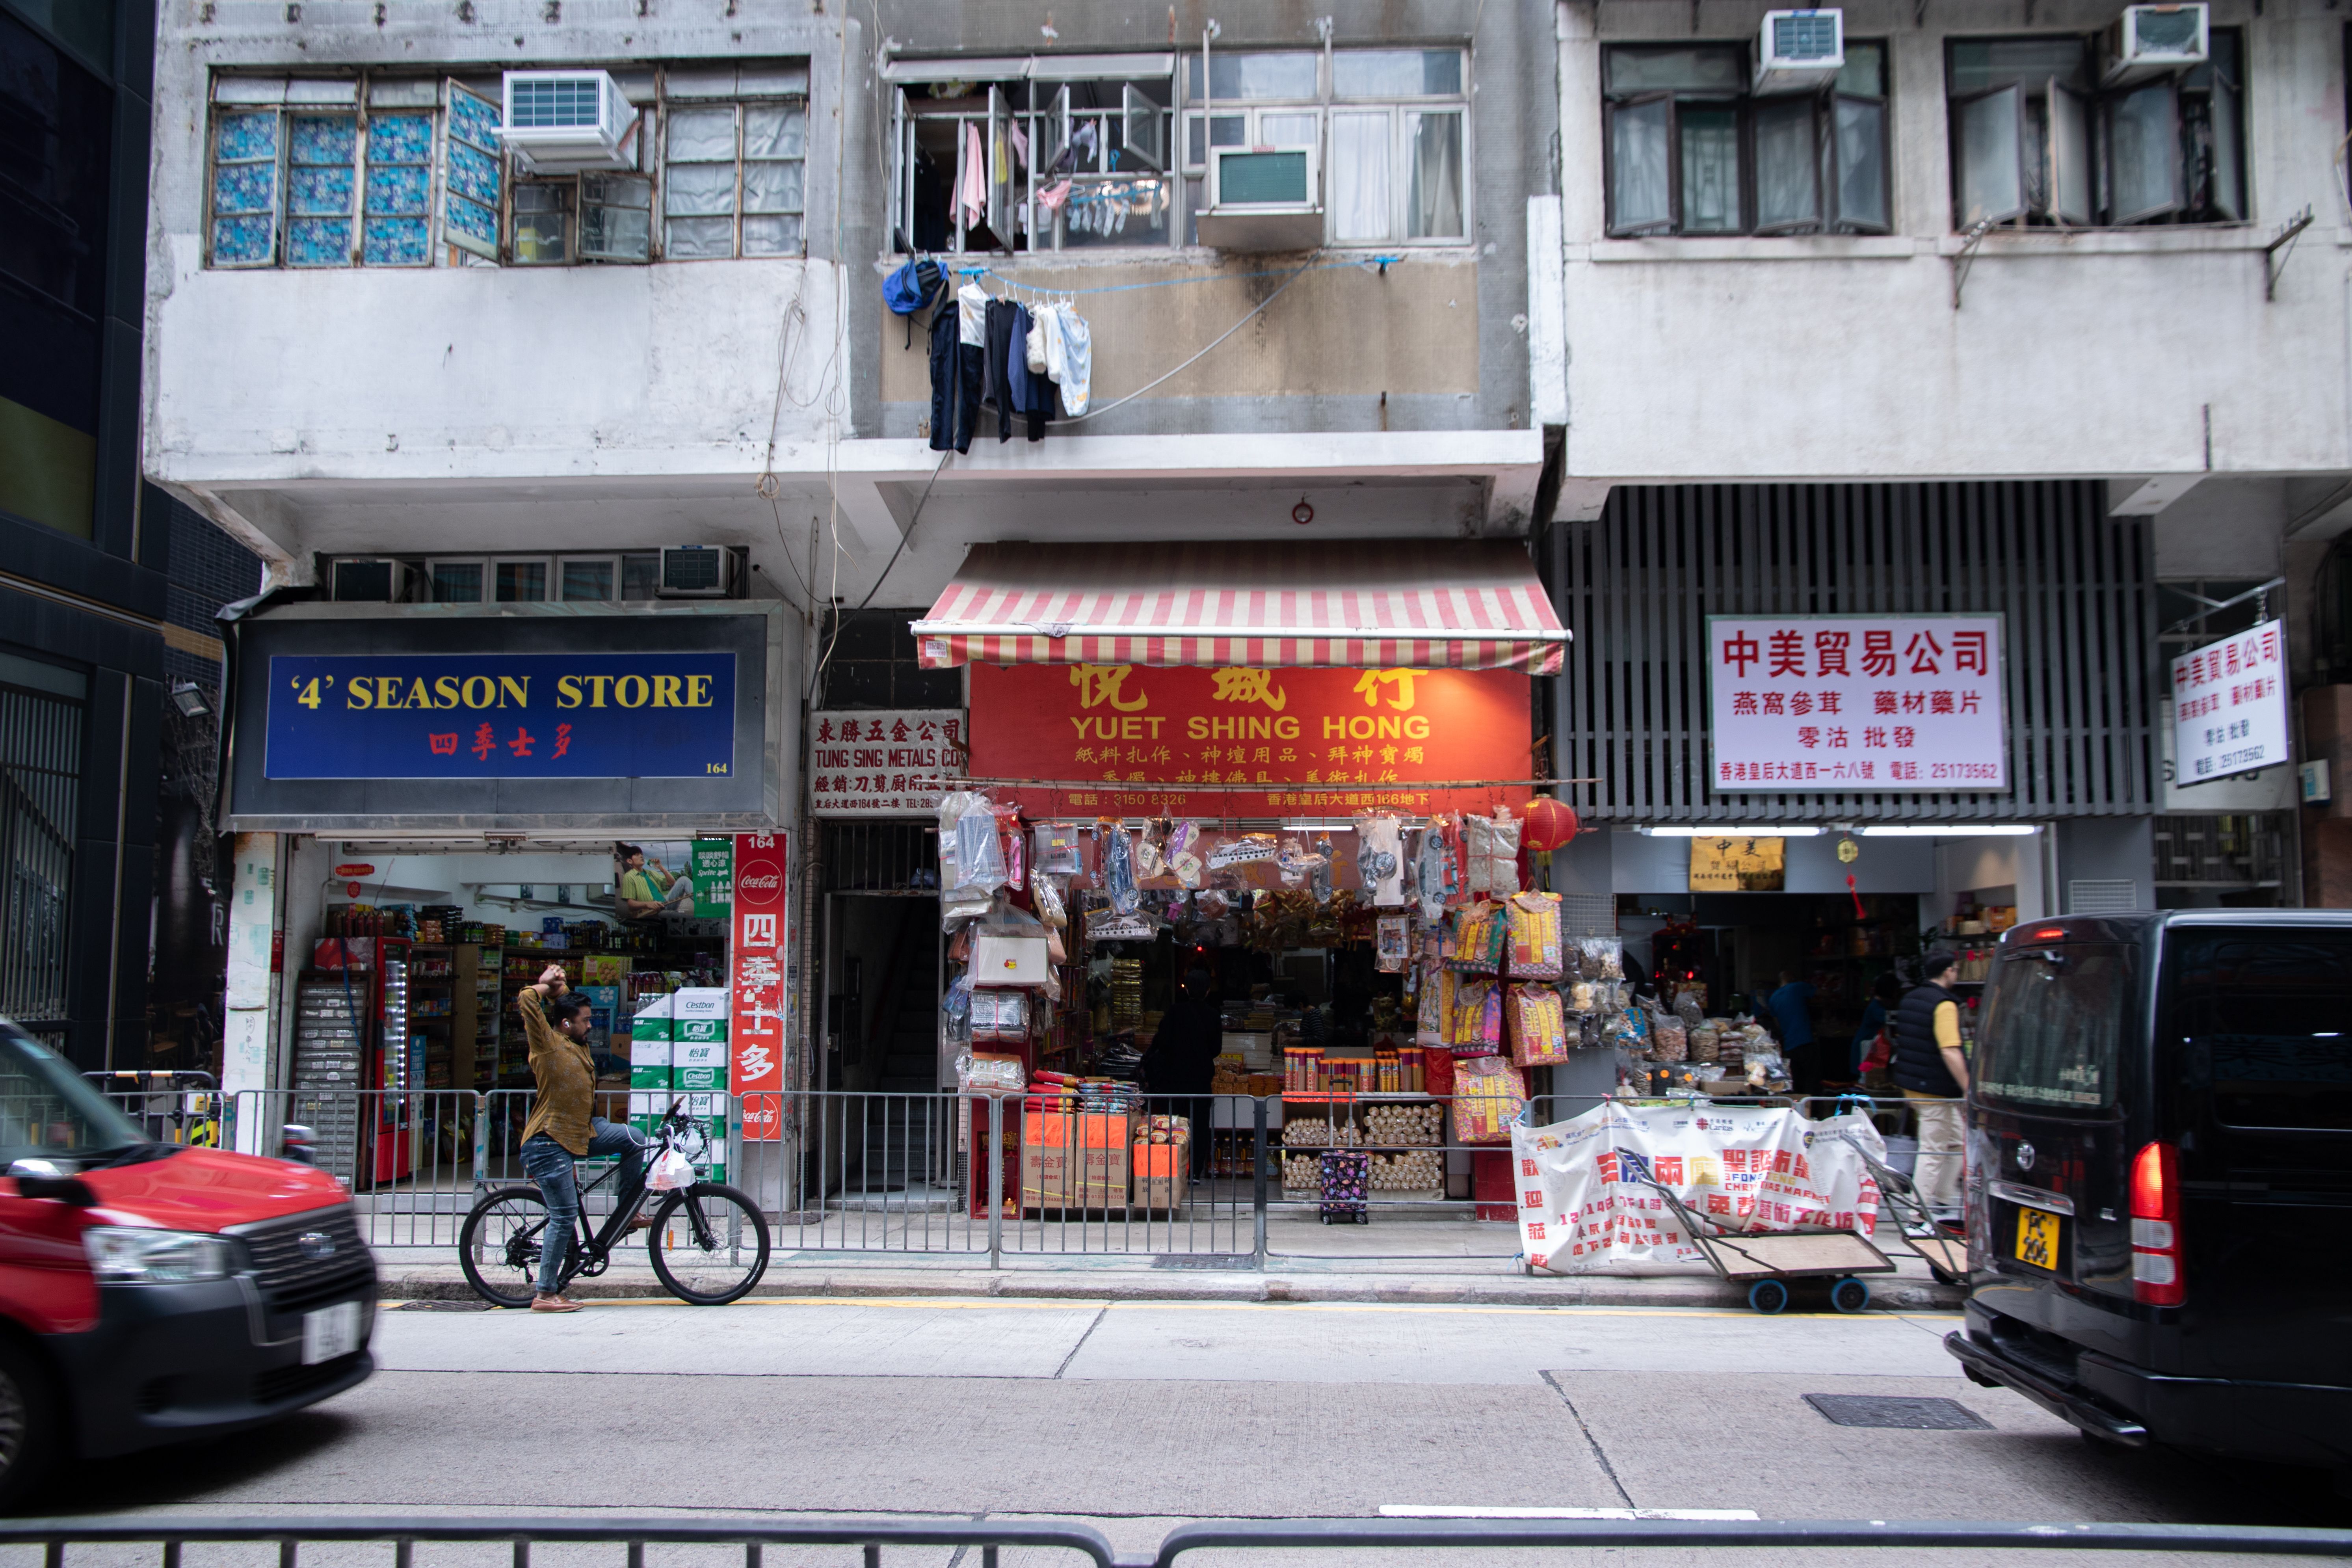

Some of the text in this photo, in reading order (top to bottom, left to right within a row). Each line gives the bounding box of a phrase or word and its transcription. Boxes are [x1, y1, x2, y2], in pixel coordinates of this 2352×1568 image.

[1723, 629, 1988, 678] 中美貿易公司
[2175, 630, 2278, 693] 中美貿易公司
[347, 675, 531, 709] SEASON
[556, 674, 714, 708] STORE
[1733, 690, 1982, 716] 燕窩參茸 藥材藥片
[815, 718, 960, 744] 東勝五金公司
[1069, 716, 1430, 739] YUET SHING HONG
[1863, 726, 1915, 748] 批發
[429, 722, 574, 761] 四季士多
[706, 763, 728, 774] 164
[815, 750, 849, 768] TUNG
[853, 750, 883, 768] SING
[888, 749, 935, 768] METALS
[1720, 761, 1875, 781] 香港皇后大道西一六八號
[1931, 763, 1997, 779] 25173562
[1114, 794, 1145, 805] 3150
[1151, 794, 1186, 805] 8326
[1267, 792, 1429, 806] 香港皇后大道西166地下
[748, 836, 775, 848] 164
[741, 875, 779, 888] Coca-Cola
[740, 913, 781, 1081] 四季士多
